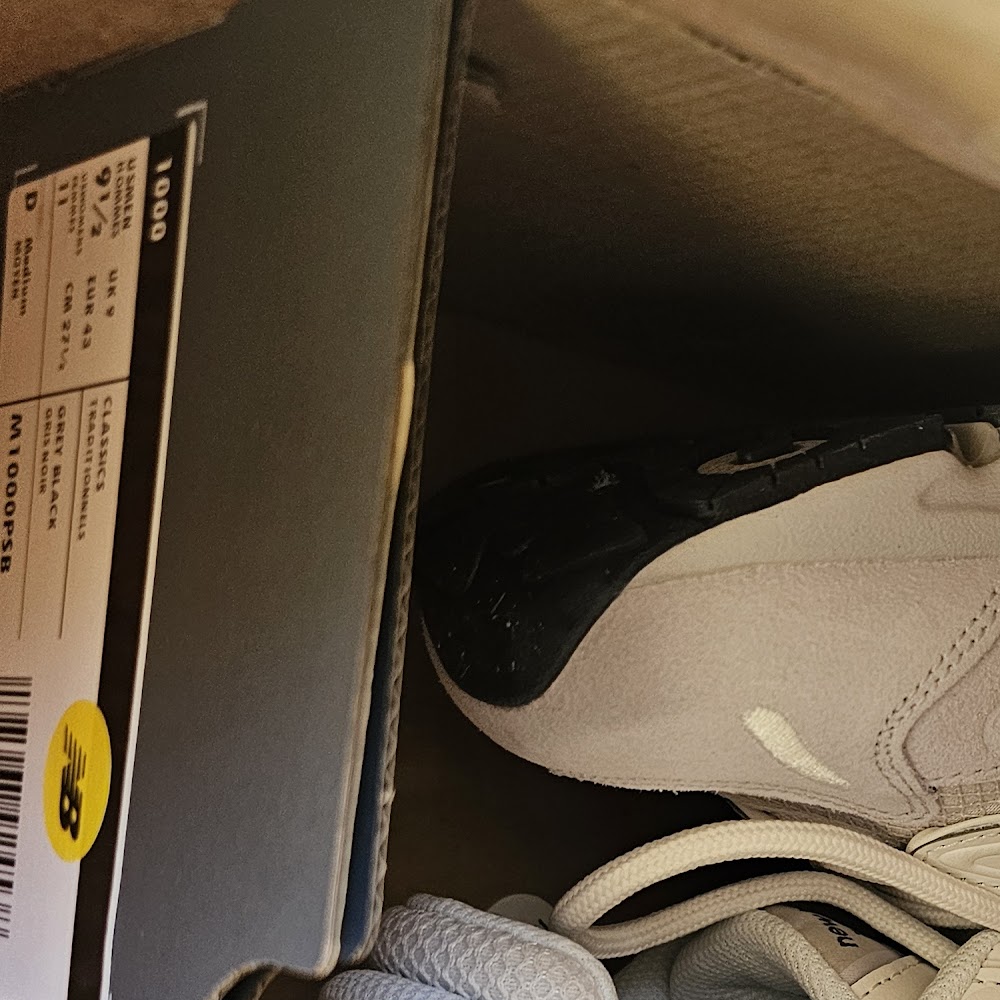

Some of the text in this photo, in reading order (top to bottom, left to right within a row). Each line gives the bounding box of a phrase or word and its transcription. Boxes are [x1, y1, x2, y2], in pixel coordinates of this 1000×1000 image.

[24, 191, 38, 212] D
[57, 180, 69, 207] 11
[149, 157, 173, 242] 1000
[19, 238, 34, 317] Medium
[63, 282, 74, 314] CM
[82, 275, 97, 350] EUR 43
[105, 269, 118, 318] UK 9
[38, 450, 49, 495] NOIR
[48, 406, 67, 531] GREY BLACK
[77, 399, 98, 541] TRADITIONNELS
[96, 396, 113, 493] CLASSICS
[1, 413, 23, 574] M1000PSB
